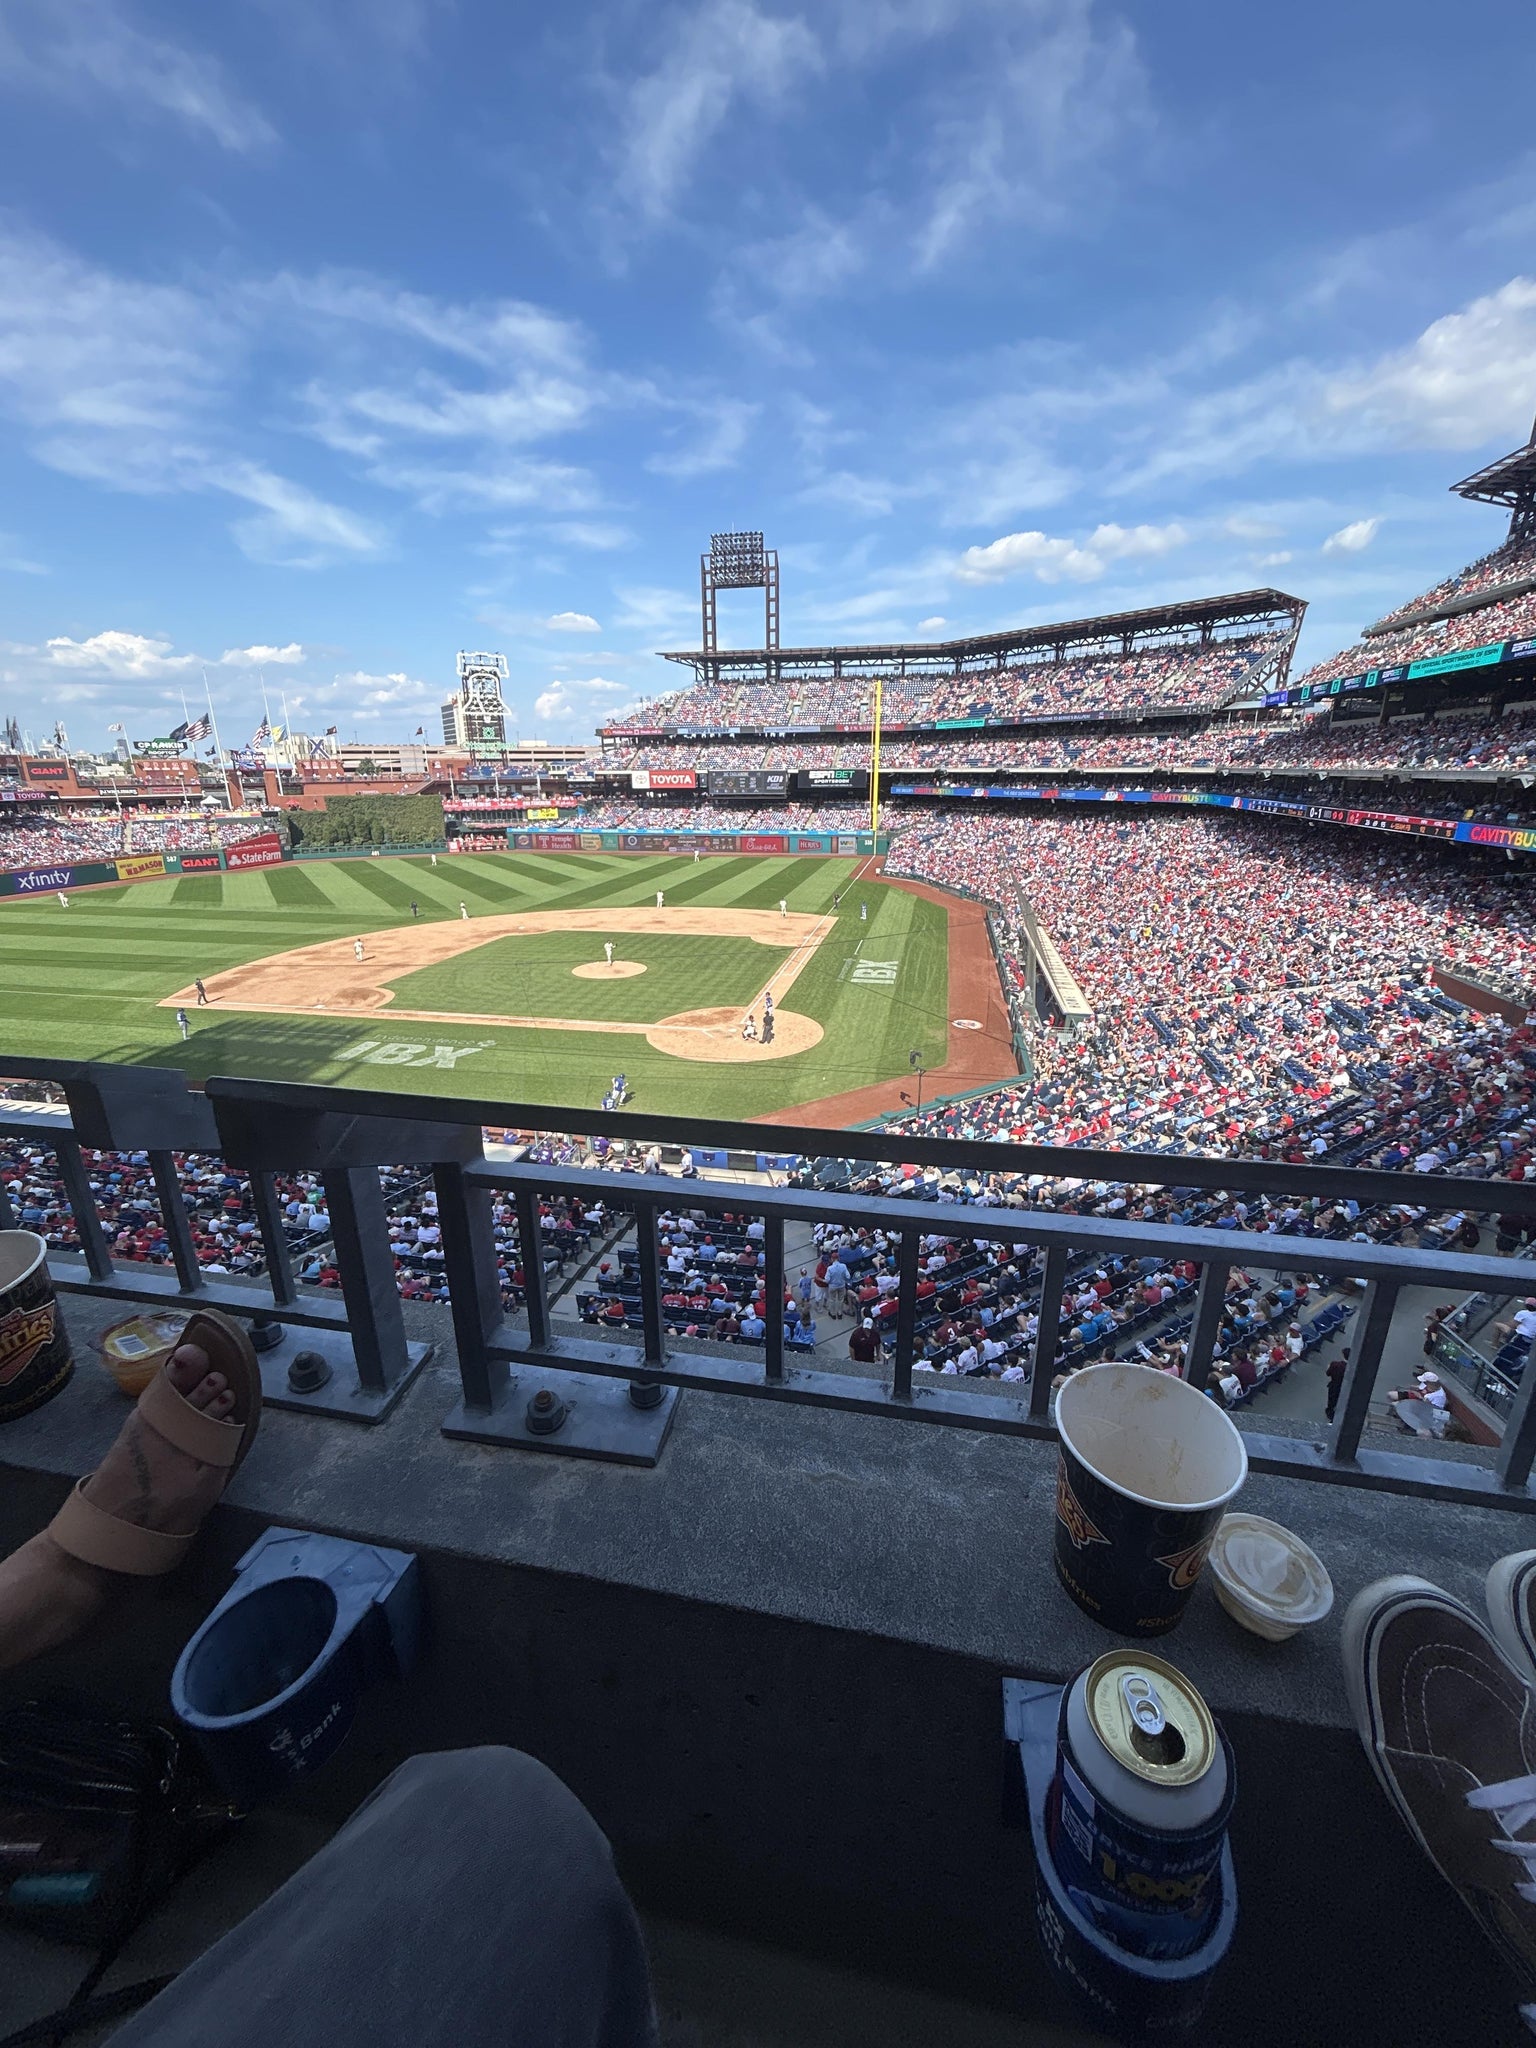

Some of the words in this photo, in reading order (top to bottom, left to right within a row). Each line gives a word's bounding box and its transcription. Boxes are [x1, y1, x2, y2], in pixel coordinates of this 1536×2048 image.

[31, 767, 64, 775] GIANT
[651, 775, 692, 784] TOYOTA
[550, 835, 573, 844] Temple
[181, 858, 219, 867] GIANT
[18, 869, 71, 890] xfinity
[300, 1702, 343, 1749] Bank
